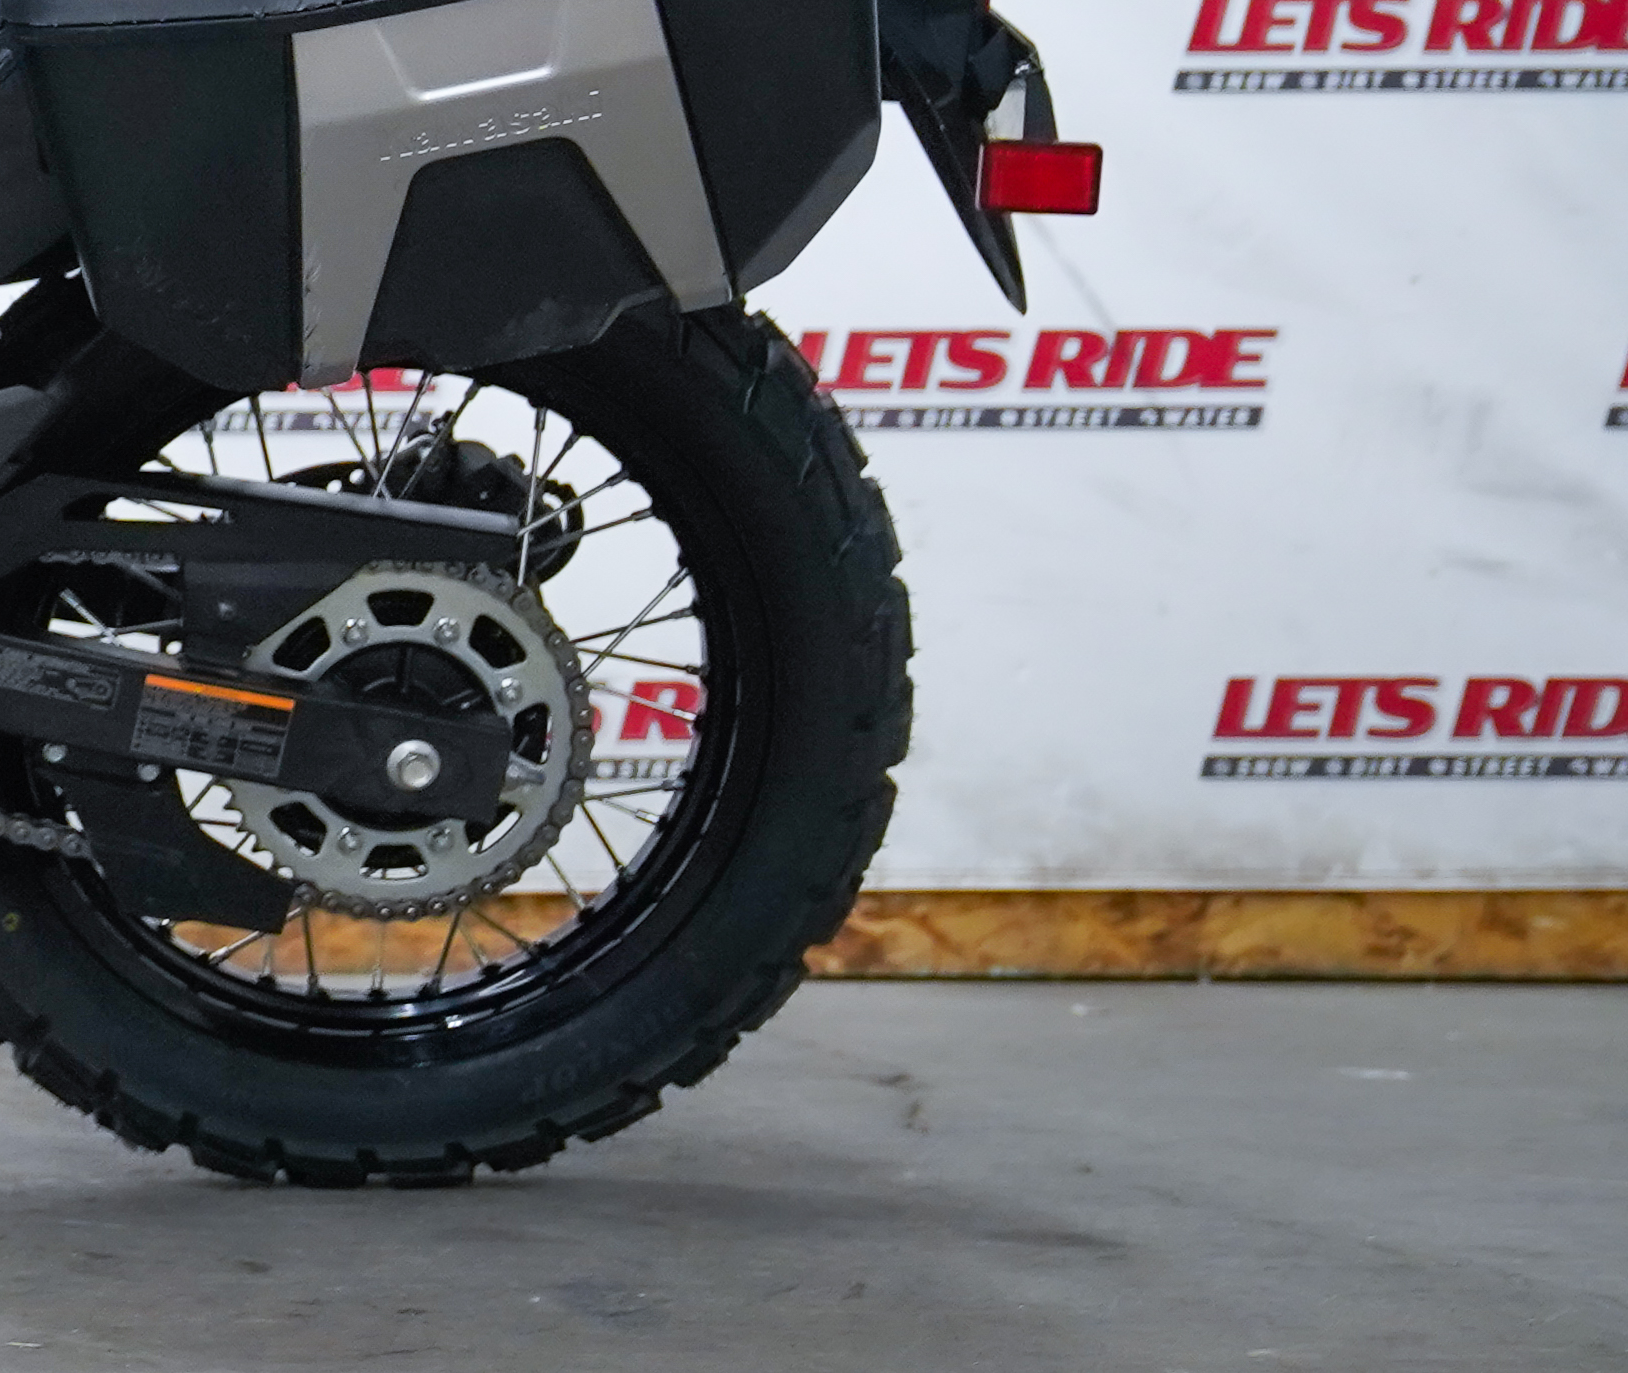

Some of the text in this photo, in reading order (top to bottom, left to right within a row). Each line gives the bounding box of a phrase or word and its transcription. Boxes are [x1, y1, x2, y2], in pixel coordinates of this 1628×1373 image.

[798, 329, 1278, 392] LETS RIDE
[1214, 678, 1628, 738] LETS RID
